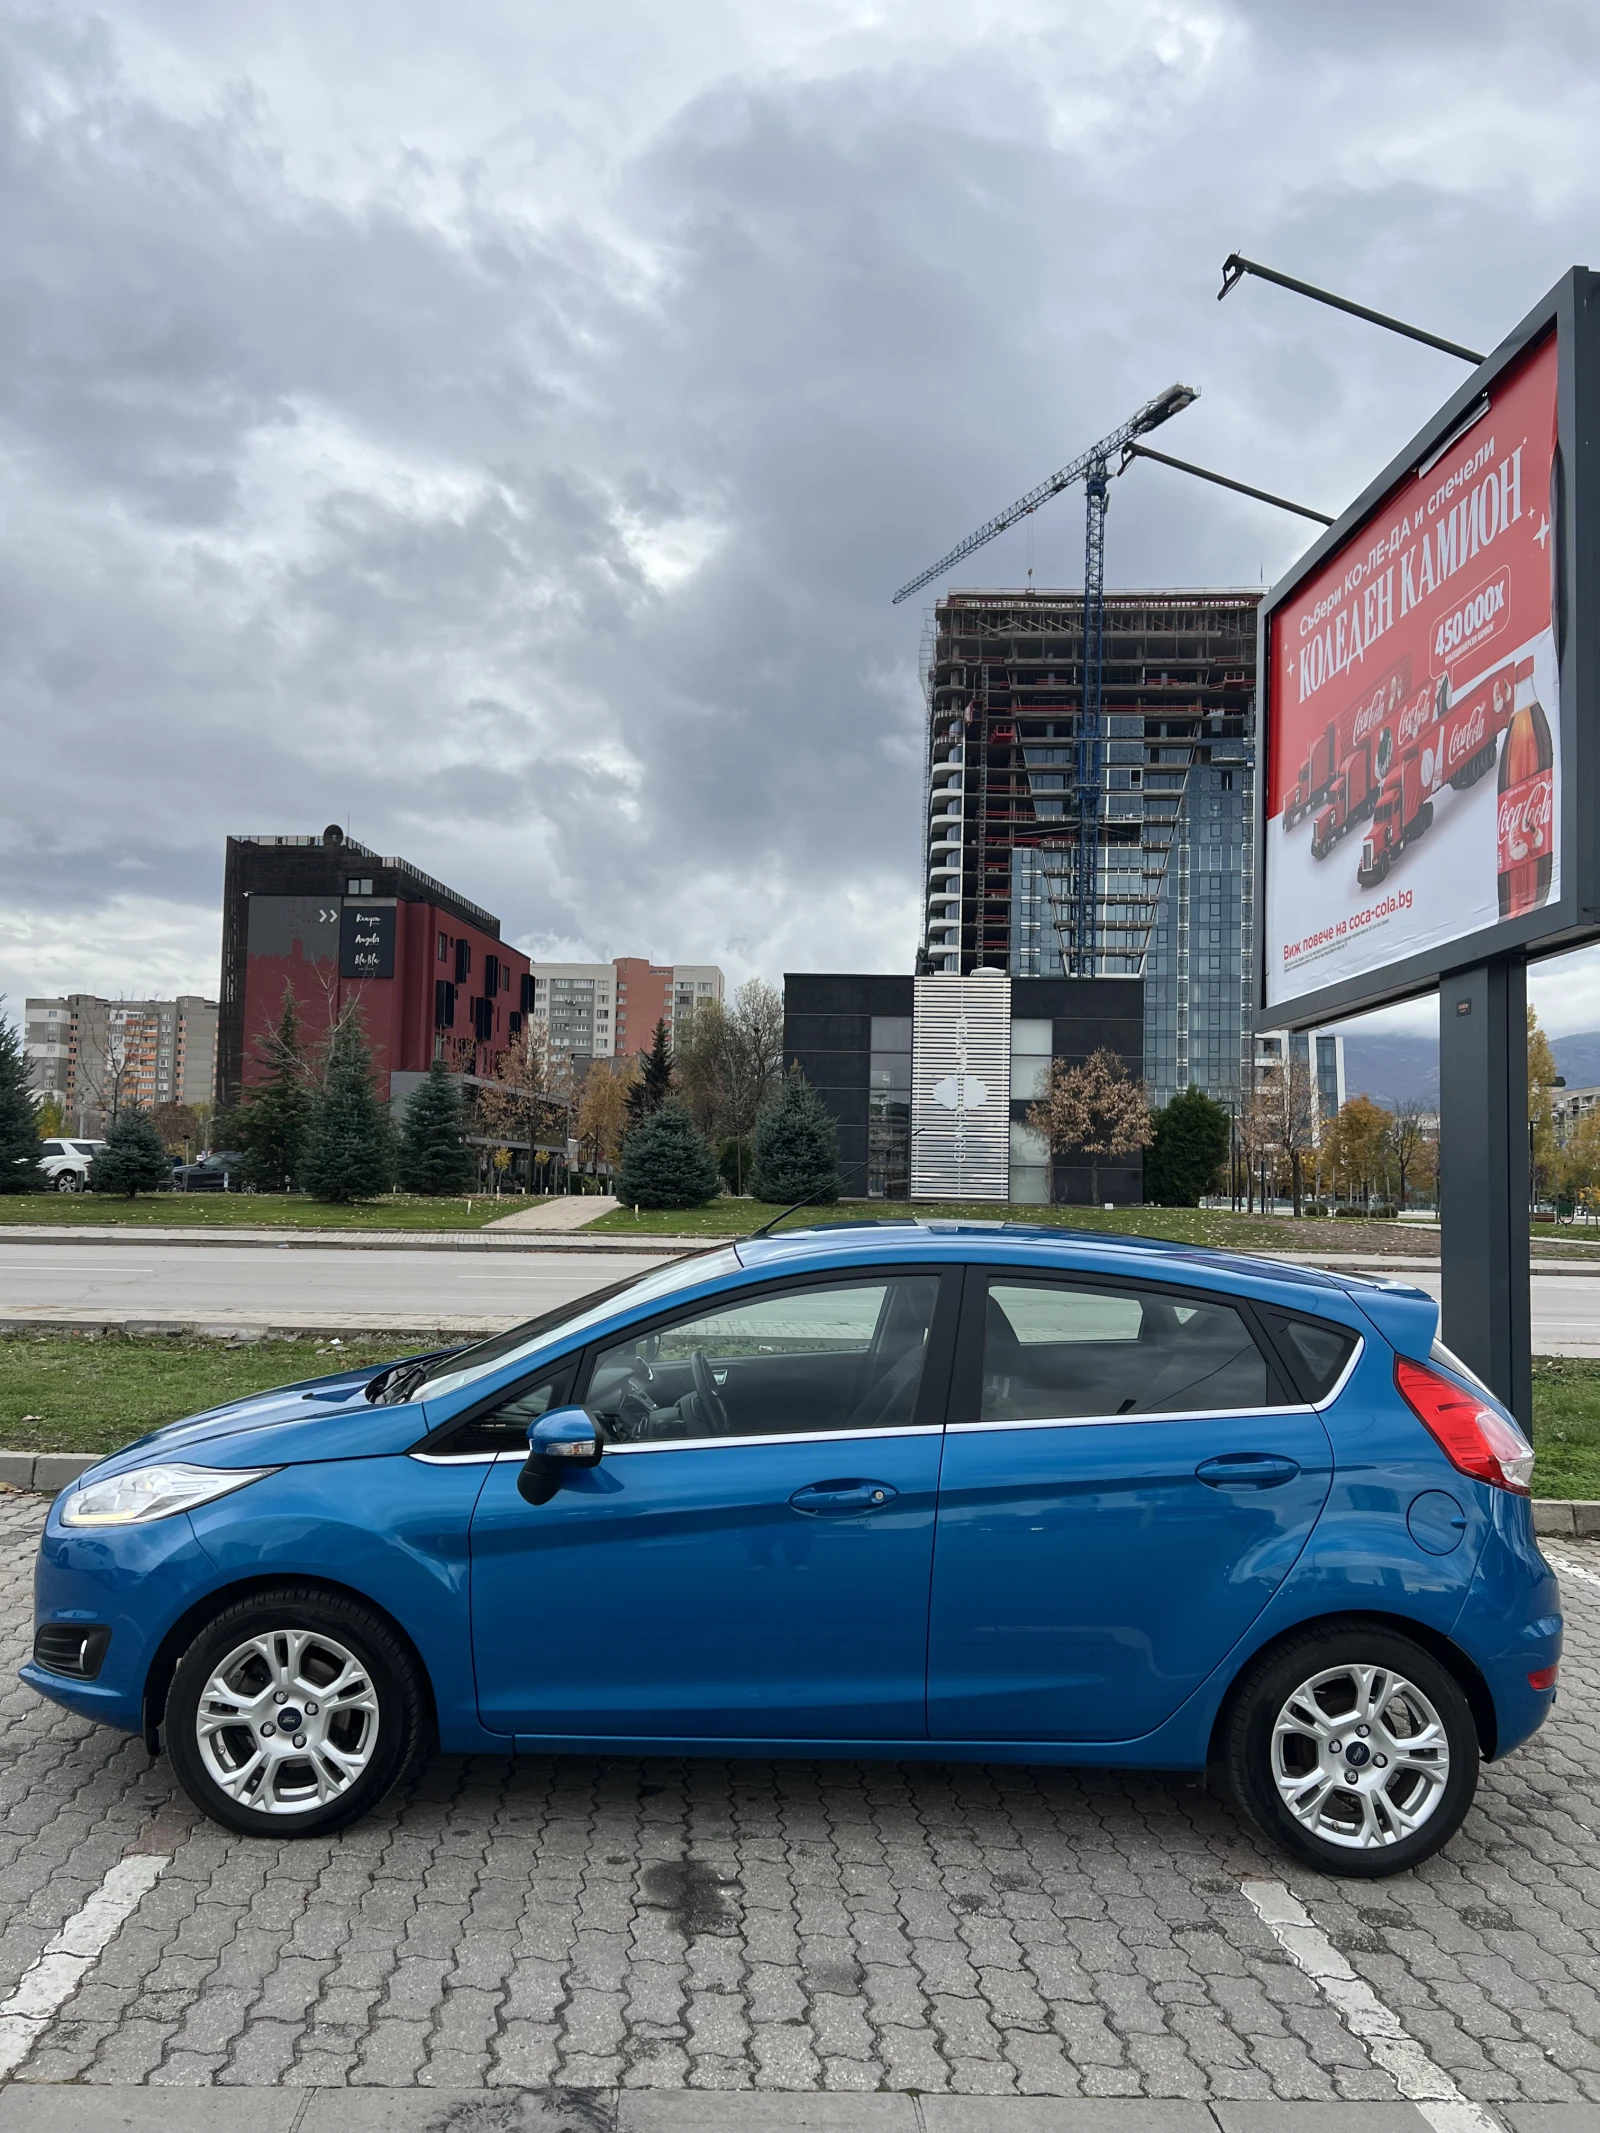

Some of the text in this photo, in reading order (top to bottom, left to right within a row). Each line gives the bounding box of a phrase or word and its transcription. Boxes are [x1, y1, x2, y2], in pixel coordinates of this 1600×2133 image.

[1300, 436, 1495, 636] Събери КО-ЛЕ-ДА и спечели
[1299, 565, 1395, 704] КОЛЕДЕН
[1498, 779, 1552, 844] Coca-Cola
[356, 913, 381, 927] Kanyon
[1283, 942, 1301, 960] Виж
[1303, 927, 1334, 951] повече
[1336, 921, 1347, 937] на
[1349, 889, 1413, 930] coca-cola.bg
[355, 953, 380, 966] Bla Bla
[954, 1108, 966, 1163] GRAND
